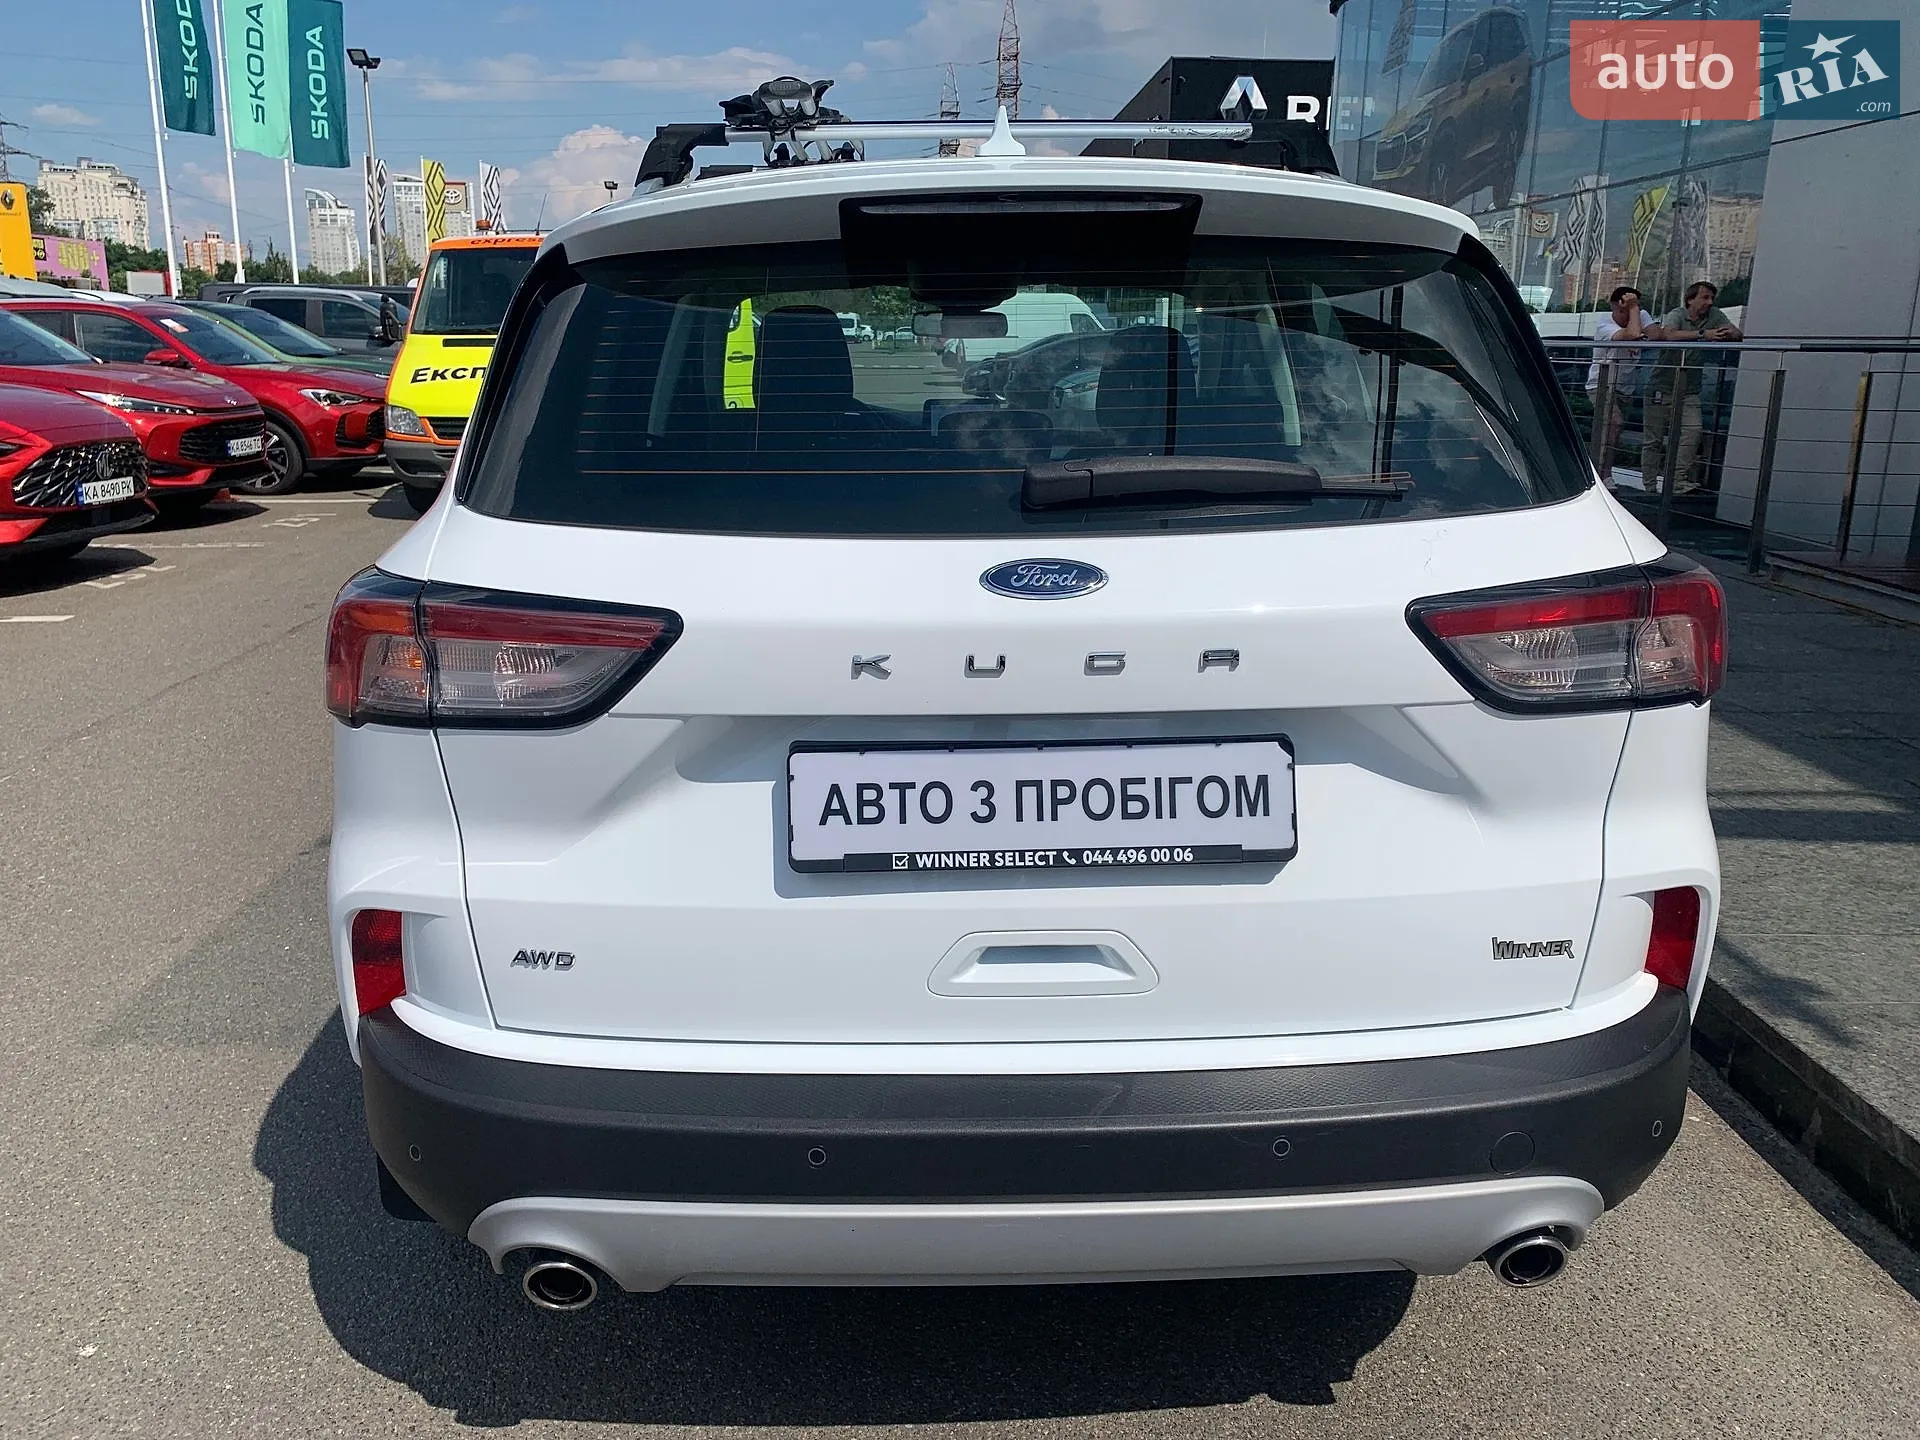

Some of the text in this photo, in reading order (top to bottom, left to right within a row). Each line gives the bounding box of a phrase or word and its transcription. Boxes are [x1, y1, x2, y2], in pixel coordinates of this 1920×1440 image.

[84, 485, 99, 501] KA
[100, 482, 121, 498] 8490
[1010, 563, 1079, 588] Ford
[851, 650, 1240, 679] KUGA
[818, 782, 953, 826] АВТО
[1015, 775, 1270, 822] ПРОБІГОМ
[915, 846, 1194, 868] WINNER SELECT 044 496 00 06
[511, 949, 575, 970] AWD
[1491, 937, 1575, 960] WINNER
